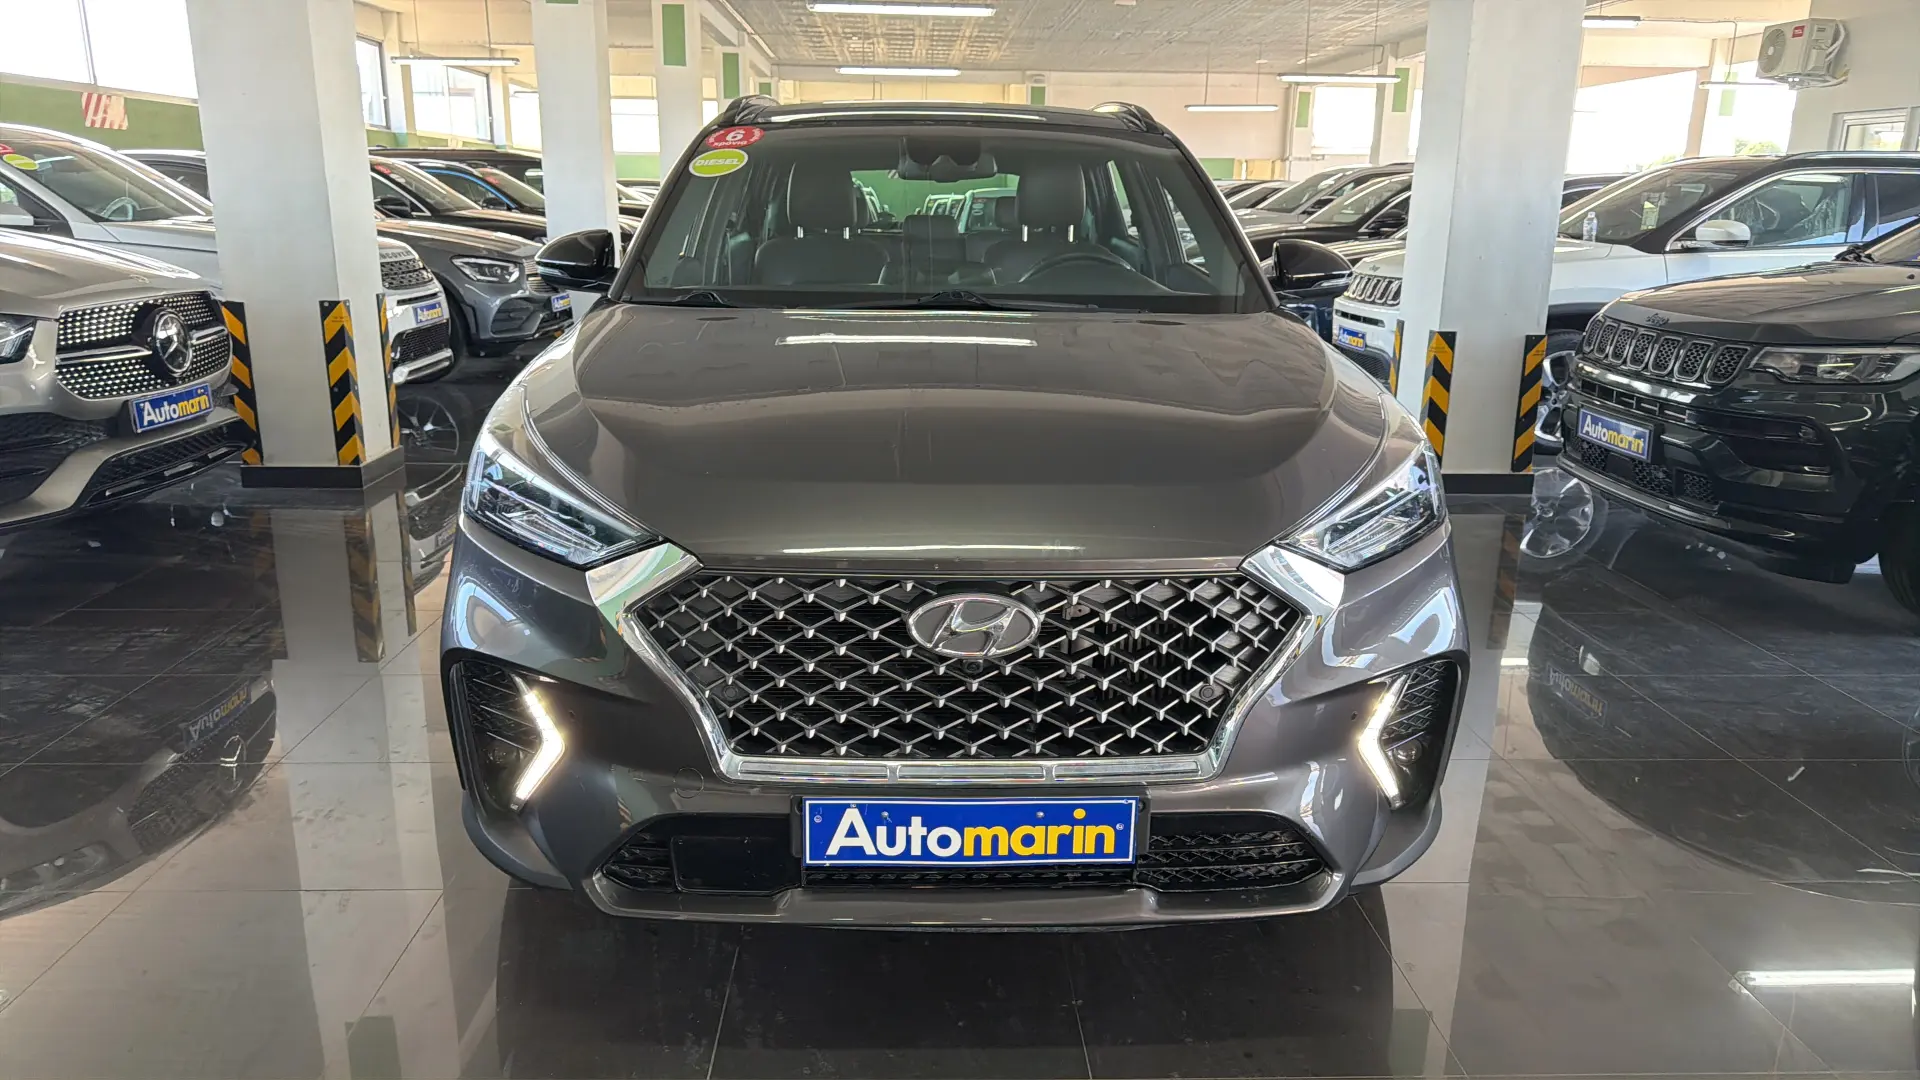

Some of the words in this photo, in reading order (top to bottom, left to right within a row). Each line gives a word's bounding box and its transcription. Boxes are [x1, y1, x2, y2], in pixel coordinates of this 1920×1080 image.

[726, 129, 746, 142] 6
[695, 158, 740, 167] DIESEL
[143, 390, 210, 426] Automarin
[1582, 414, 1644, 454] Automarin
[825, 807, 1116, 857] Automarin
